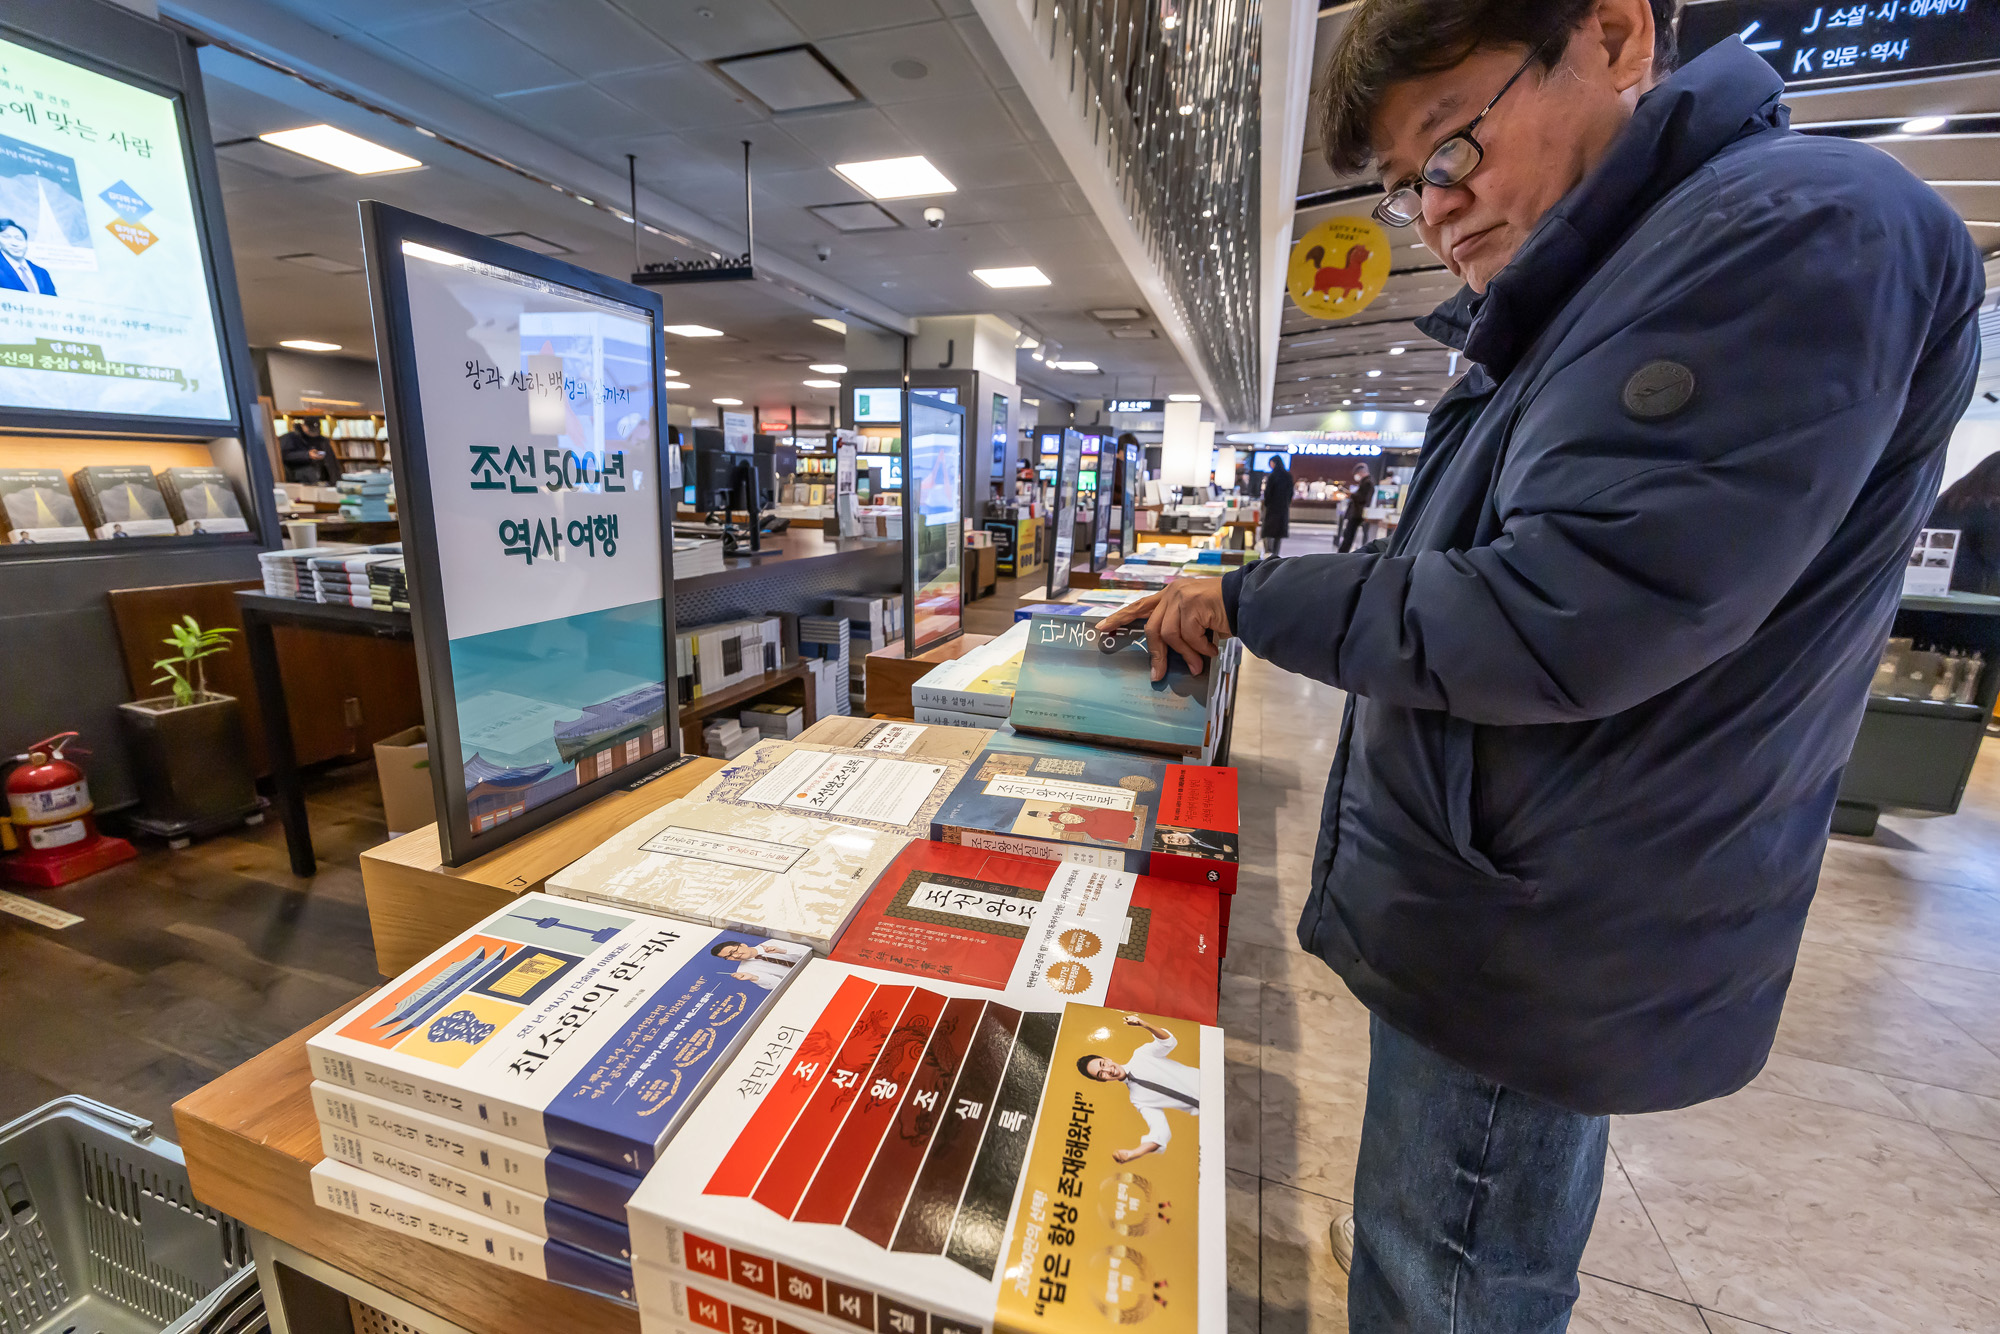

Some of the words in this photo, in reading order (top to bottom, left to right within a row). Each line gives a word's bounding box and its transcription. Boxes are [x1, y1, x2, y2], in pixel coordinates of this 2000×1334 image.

[1802, 9, 1823, 34] J
[1792, 48, 1817, 74] K
[46, 110, 98, 143] 맞는
[108, 132, 154, 159] 사람
[465, 360, 504, 390] 왕과
[469, 445, 539, 494] 조선
[544, 450, 626, 494] 500년
[1287, 443, 1382, 456] STARBUCKS
[498, 514, 562, 565] 역사
[567, 513, 619, 558] 여행
[921, 693, 929, 702] 나
[932, 695, 948, 705] 사용
[951, 696, 975, 708] 설명서
[809, 760, 864, 807] 조선왕조실록
[997, 785, 1118, 805] 조선왕조실록
[971, 838, 1053, 859] 조선왕조실록
[543, 987, 572, 1018] 역사가
[571, 965, 600, 994] 단숨에
[598, 940, 631, 968] 이해되는
[1027, 971, 1040, 988] 탄탄한
[1034, 953, 1046, 970] 고증의
[1060, 966, 1069, 986] 2017년
[506, 983, 620, 1081] 최소한의
[613, 928, 681, 983] 한국사
[589, 1065, 609, 1082] 책이
[605, 1048, 626, 1064] 역사
[623, 1004, 668, 1047] 교과서였다면
[590, 1081, 612, 1099] 역사
[608, 1054, 636, 1079] 공부가
[632, 1044, 646, 1053] 더
[642, 1028, 661, 1043] 쉽고
[625, 1070, 644, 1088] 20만
[639, 1049, 662, 1071] 독자가
[658, 1031, 678, 1049] 선택한
[674, 1019, 690, 1031] 역사
[737, 1025, 805, 1101] 설민석의
[1057, 1091, 1095, 1199] 존재해왔다!”
[1030, 1190, 1049, 1223] 선택!
[1047, 1201, 1079, 1247] 항상
[1034, 1253, 1072, 1317] “답은
